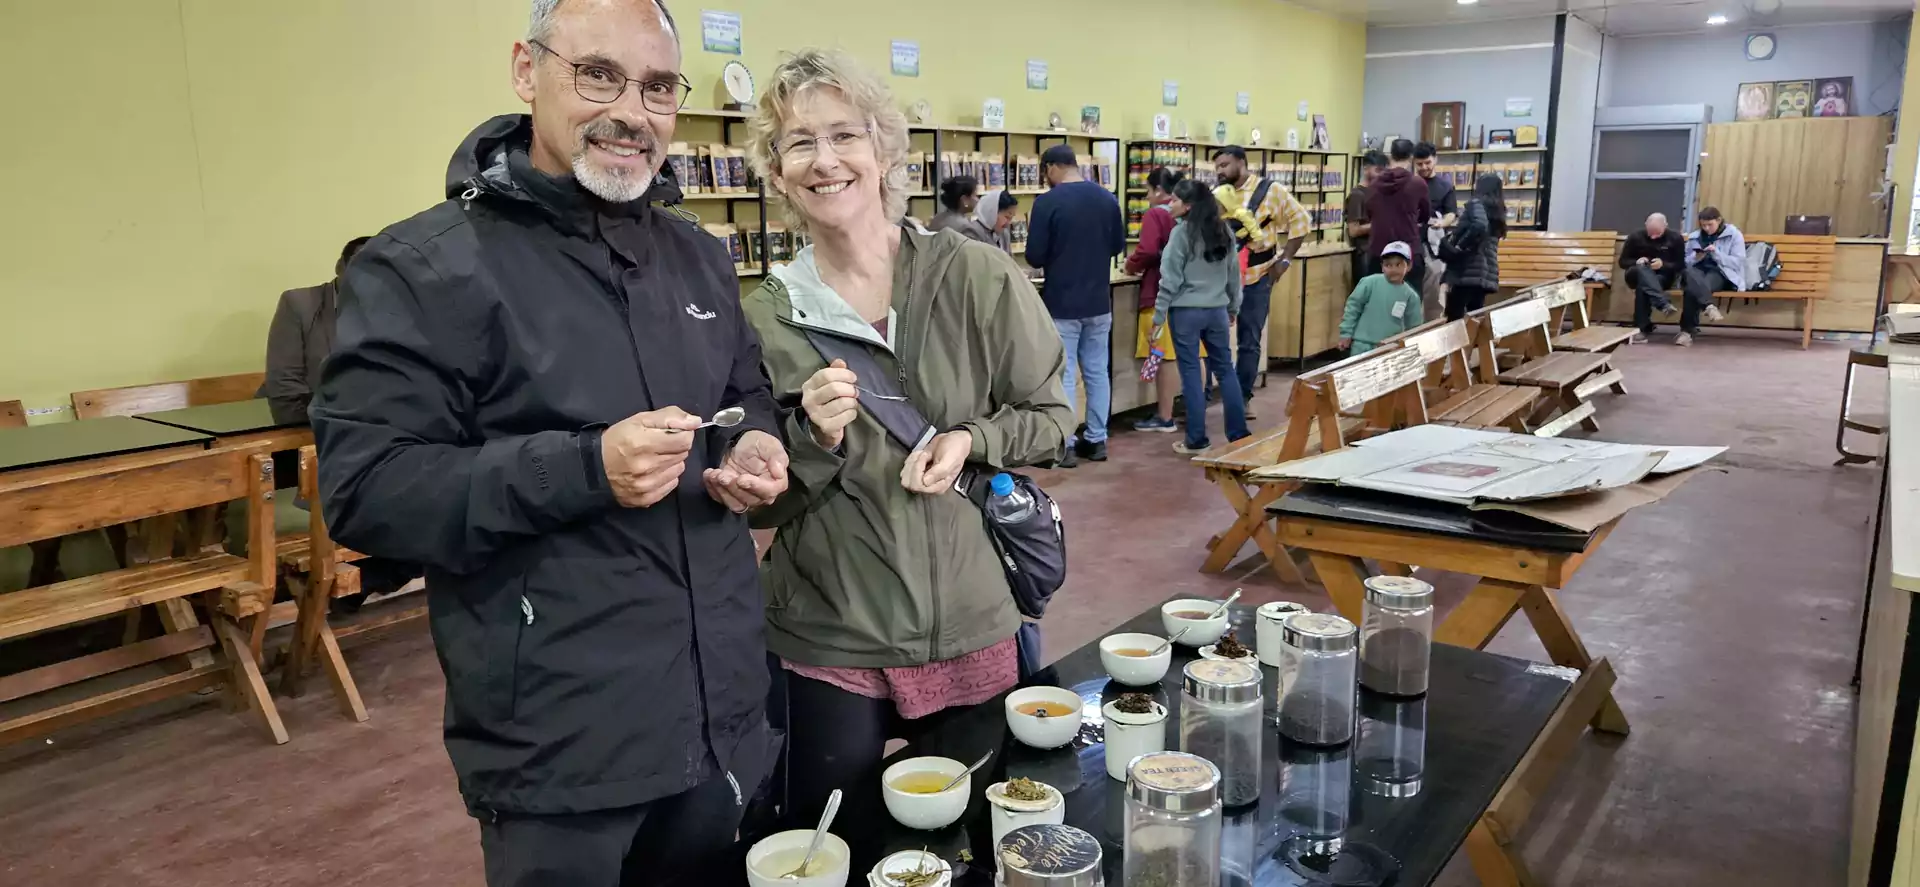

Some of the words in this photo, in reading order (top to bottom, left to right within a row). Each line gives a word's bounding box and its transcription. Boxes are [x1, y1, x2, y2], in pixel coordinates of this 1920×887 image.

[1141, 768, 1165, 776] TEA
[1009, 831, 1043, 854] Tea
[1040, 825, 1086, 874] White
